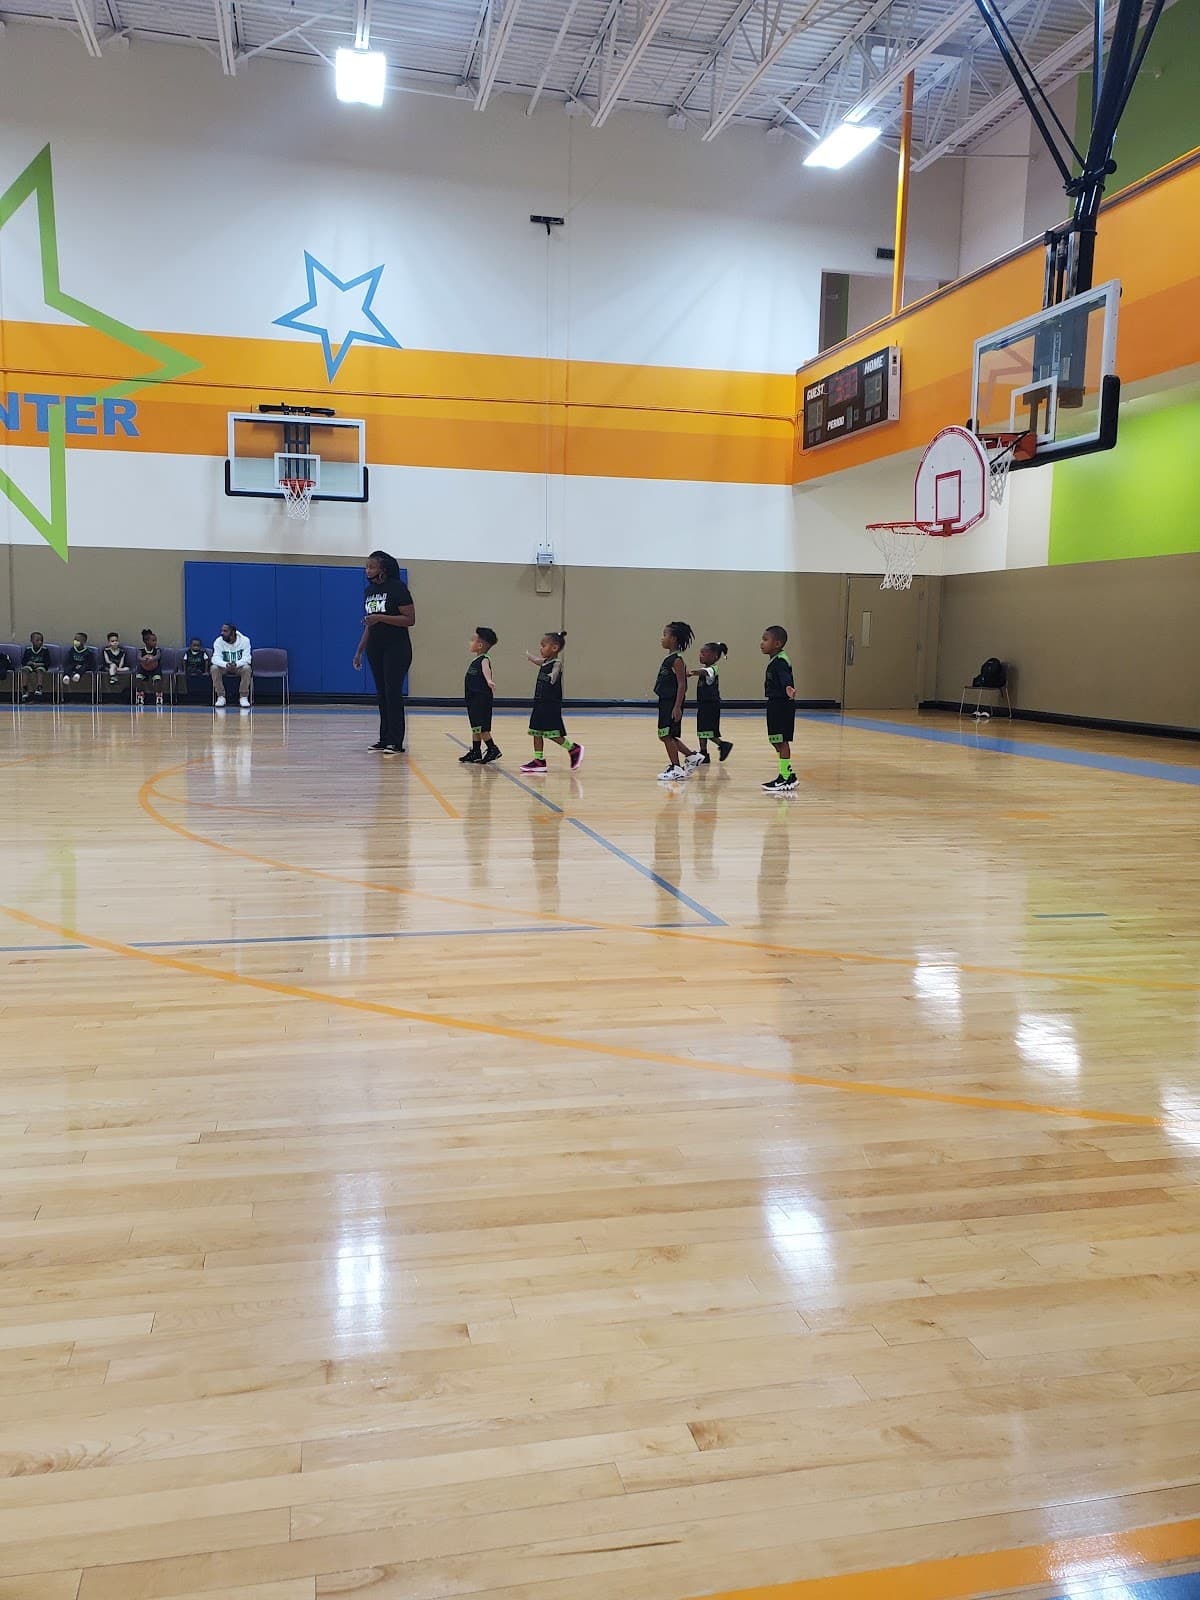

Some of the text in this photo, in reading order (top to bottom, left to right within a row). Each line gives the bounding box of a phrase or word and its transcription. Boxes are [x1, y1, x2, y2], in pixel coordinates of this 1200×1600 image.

[864, 356, 884, 374] HOME
[807, 383, 825, 401] GUEST
[827, 416, 845, 431] PERIOD
